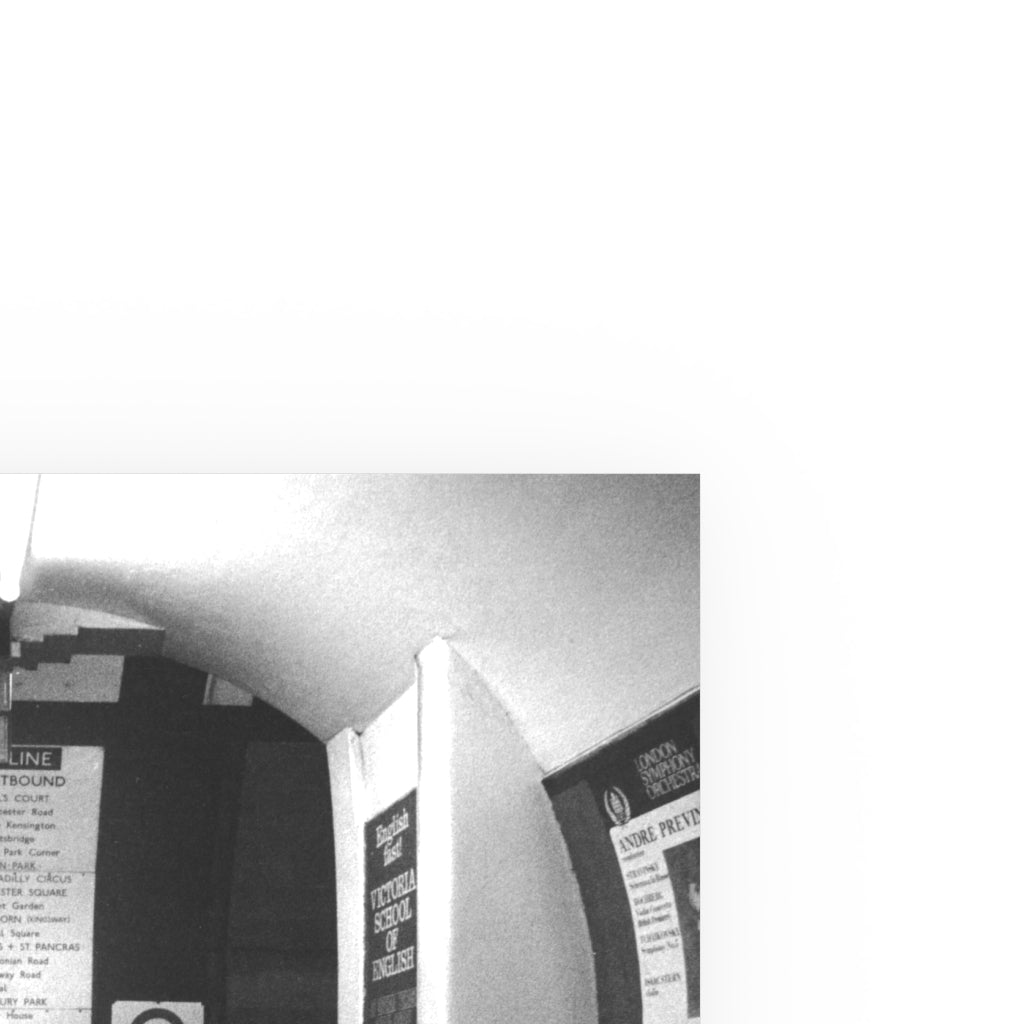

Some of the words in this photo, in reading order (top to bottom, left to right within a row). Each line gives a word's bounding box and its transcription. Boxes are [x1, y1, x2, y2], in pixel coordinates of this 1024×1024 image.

[9, 752, 53, 766] LINE
[633, 740, 677, 772] LONDON
[640, 747, 695, 785] SYMPHONY
[15, 794, 50, 803] COURT
[31, 808, 54, 817] Road
[6, 822, 56, 832] Kensington
[376, 808, 409, 848] English
[4, 849, 23, 857] Park
[29, 849, 60, 858] Corner
[12, 861, 37, 871] PARK
[36, 875, 72, 884] CIRCUS
[28, 888, 68, 897] SQUARE
[370, 867, 417, 911] VICTORIA
[12, 901, 45, 910] Garden
[374, 896, 413, 934] SCHOOL
[10, 929, 41, 939] Square
[386, 927, 399, 953] OF
[36, 943, 81, 953] PANCRAS
[28, 956, 49, 965] Road
[372, 945, 415, 981] ENGLISH
[20, 970, 42, 979] Road
[23, 998, 48, 1006] PARK
[6, 1011, 33, 1020] House
